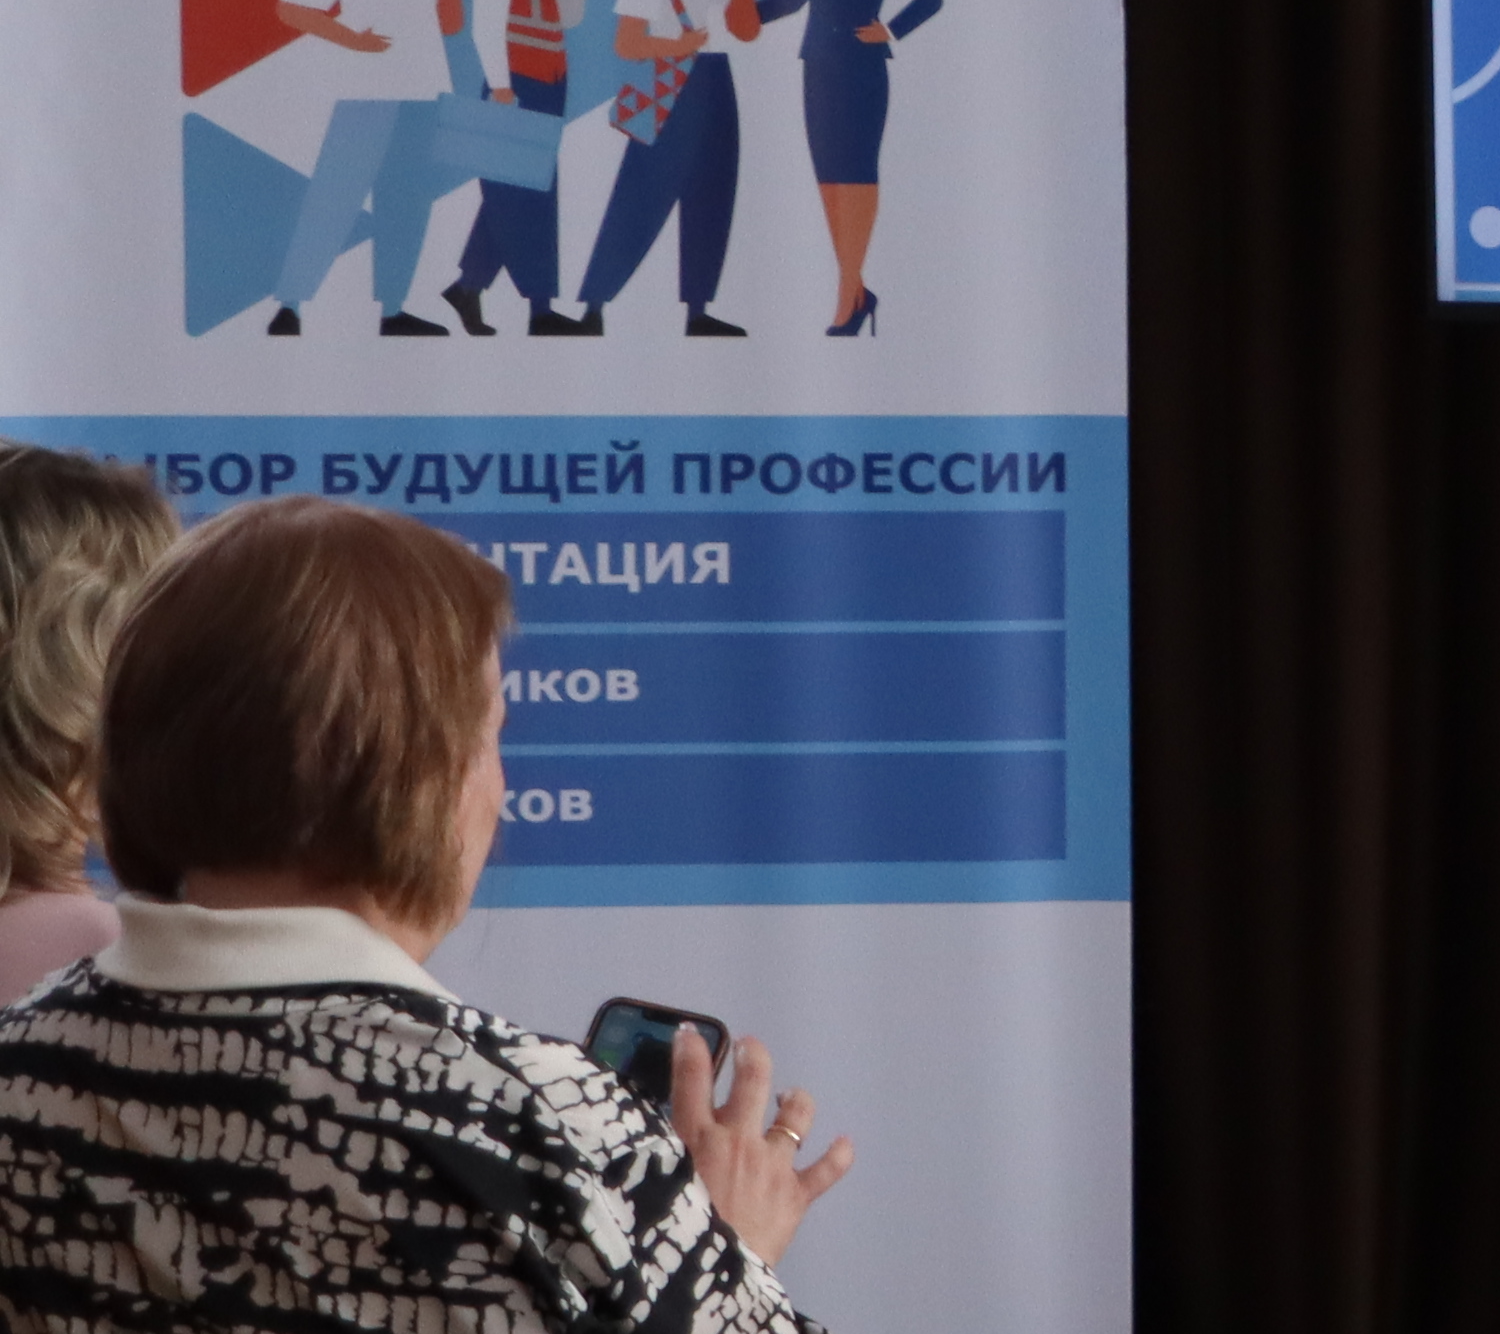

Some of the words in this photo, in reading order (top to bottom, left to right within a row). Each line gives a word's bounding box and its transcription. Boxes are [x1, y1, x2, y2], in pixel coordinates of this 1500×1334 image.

[145, 453, 296, 496] БОР
[322, 440, 646, 503] БУДУЩЕЙ
[673, 452, 1068, 495] ПРОФЕССИИ
